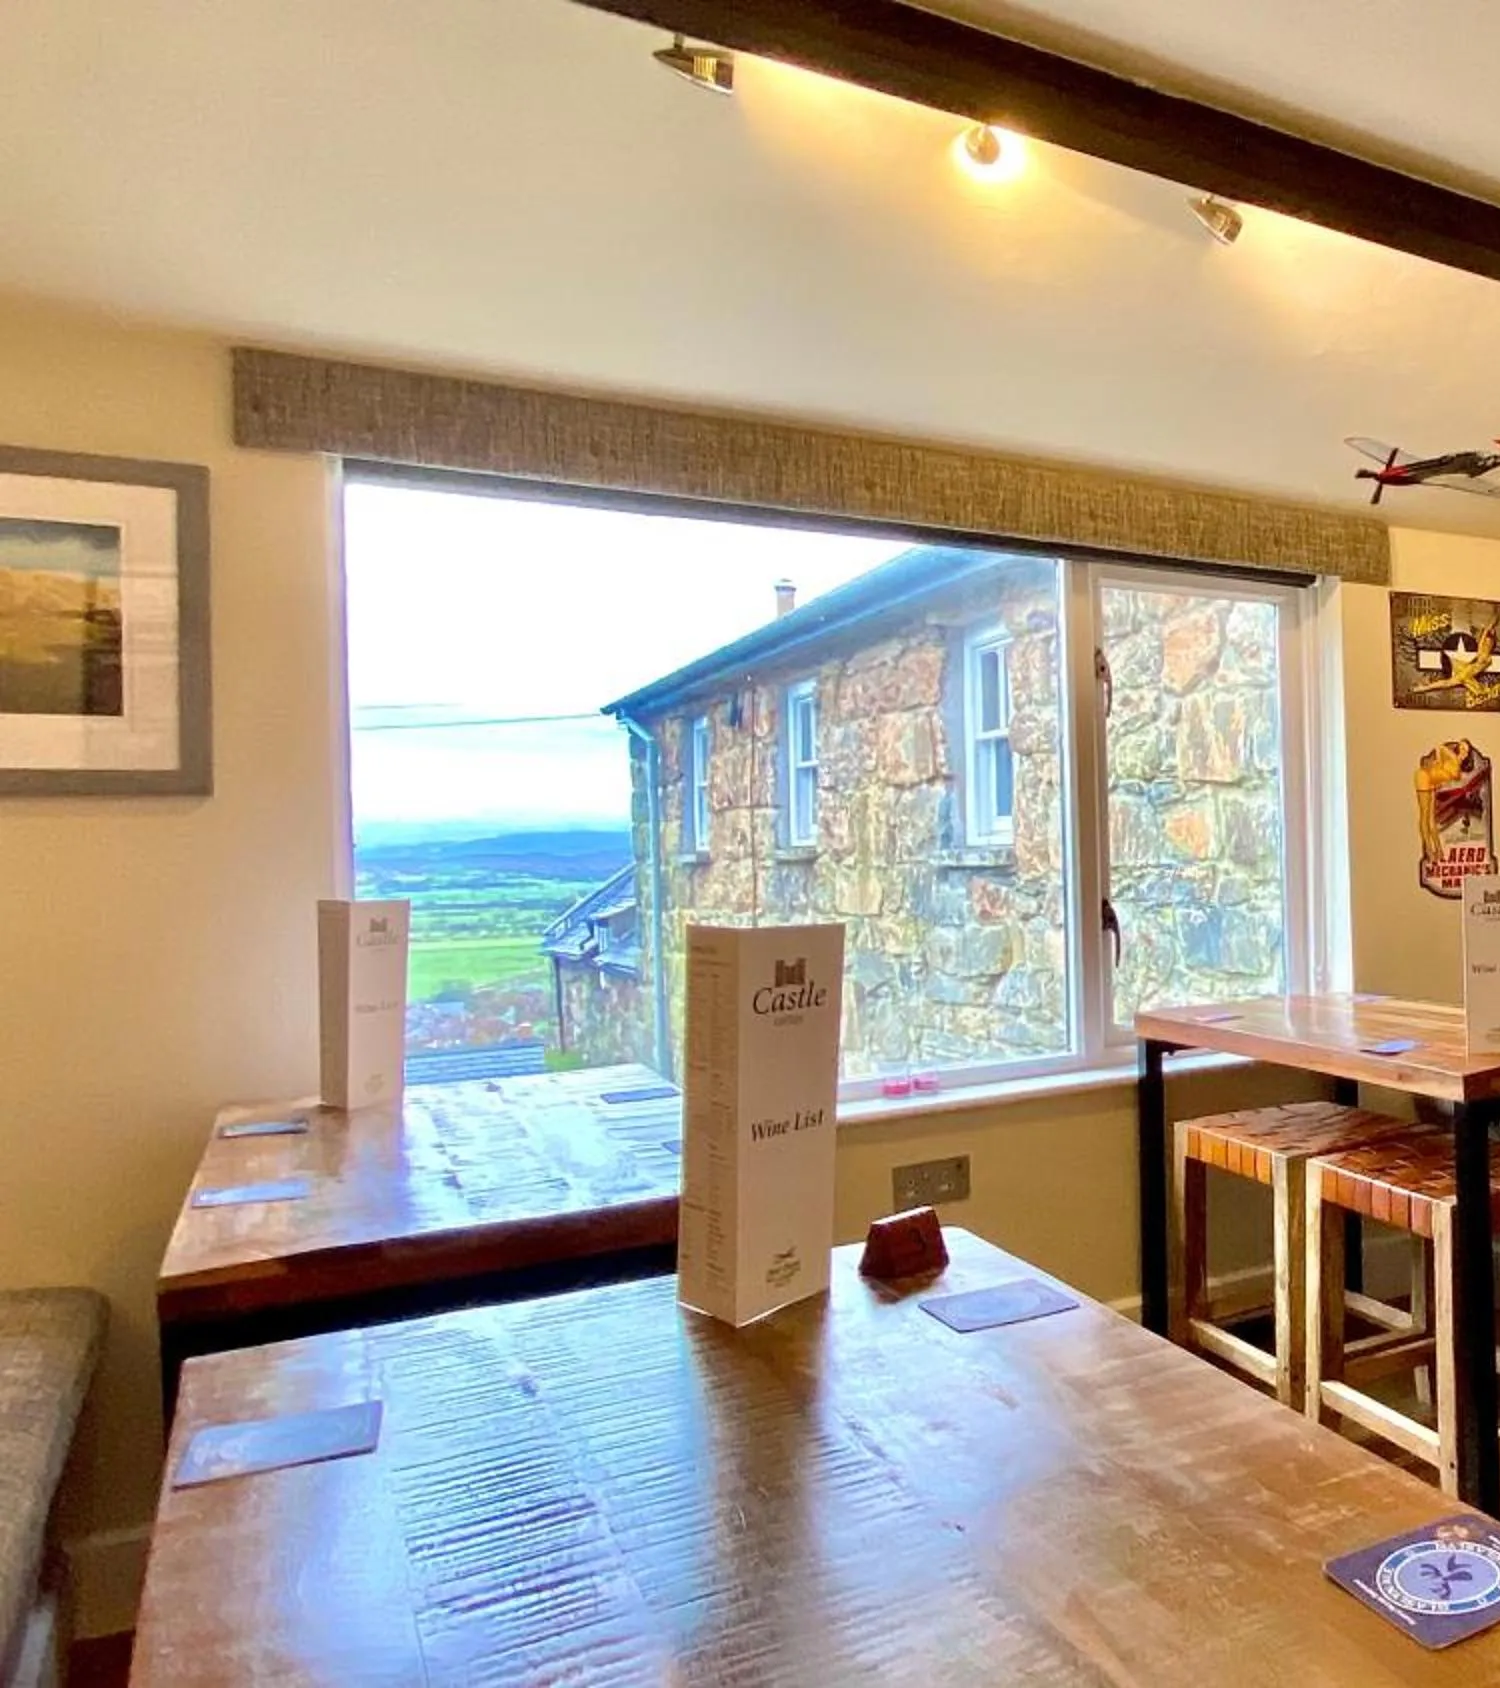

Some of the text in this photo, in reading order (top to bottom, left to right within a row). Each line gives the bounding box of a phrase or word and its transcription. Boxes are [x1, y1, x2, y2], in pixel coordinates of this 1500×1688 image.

[1408, 613, 1451, 637] Miss
[1447, 847, 1486, 863] AERO
[1441, 879, 1462, 888] MA
[752, 980, 827, 1015] Castle
[750, 1109, 825, 1143] Wine List
